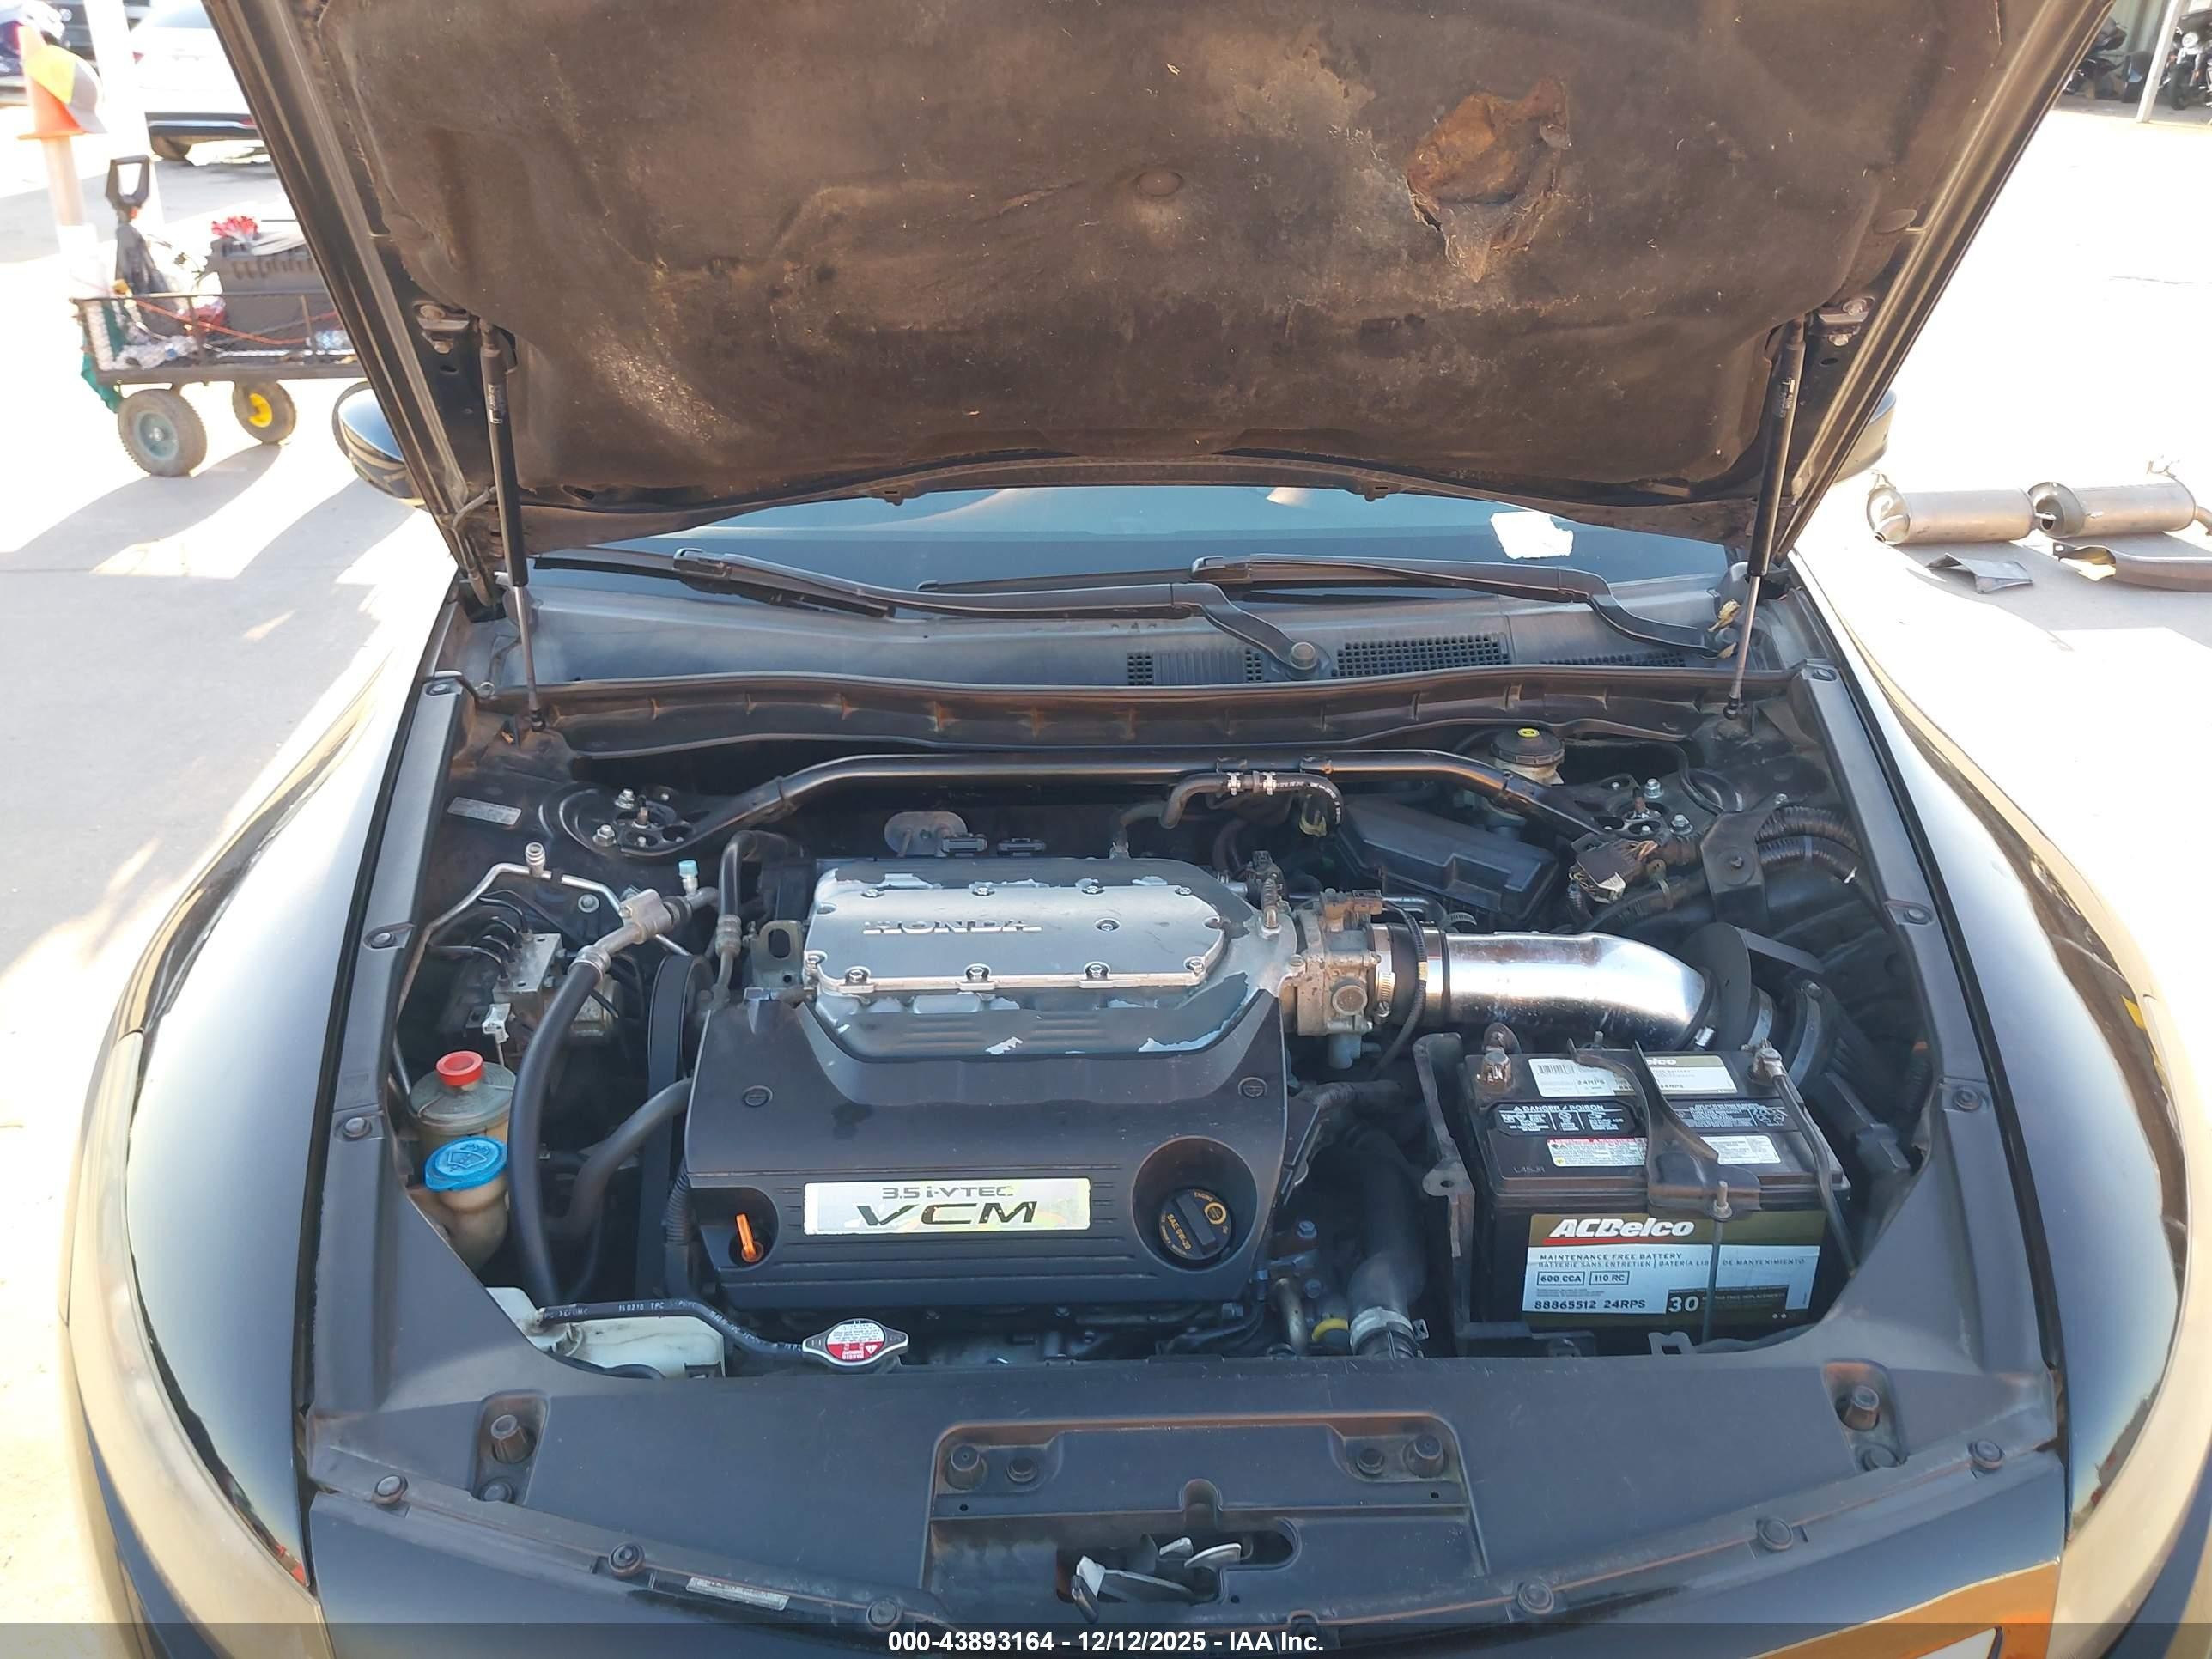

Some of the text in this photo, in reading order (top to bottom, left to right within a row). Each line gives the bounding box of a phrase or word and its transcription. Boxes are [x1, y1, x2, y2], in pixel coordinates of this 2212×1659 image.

[862, 920, 1042, 935] HONDA
[1645, 1058, 1677, 1066] elco
[881, 1187, 920, 1200] 3.5
[856, 1200, 1038, 1226] VCM
[1548, 1217, 1696, 1238] ACDelco
[1540, 1275, 1560, 1284] 600
[1534, 1299, 1647, 1310] 88865512 24RPS
[1668, 1296, 1700, 1313] 30
